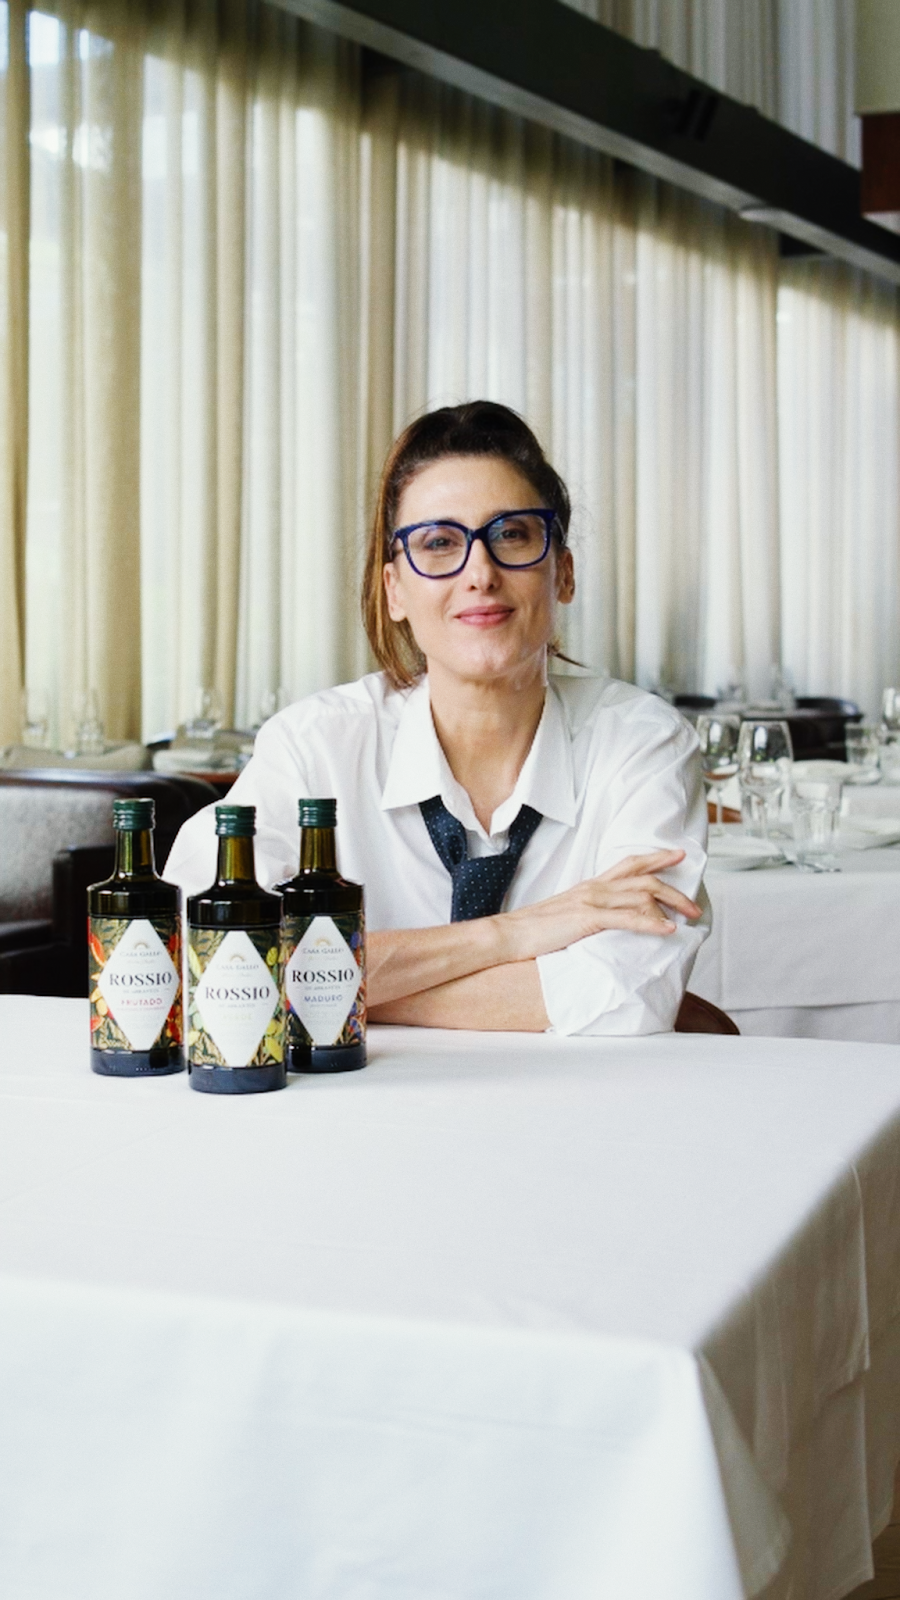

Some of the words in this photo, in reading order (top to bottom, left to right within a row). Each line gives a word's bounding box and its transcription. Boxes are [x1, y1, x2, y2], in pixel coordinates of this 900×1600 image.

[109, 971, 172, 986] ROSSIO
[292, 968, 354, 983] ROSSIO
[205, 986, 270, 1001] ROSSIO
[303, 995, 343, 1003] MADURO
[121, 998, 163, 1006] FRUTADO
